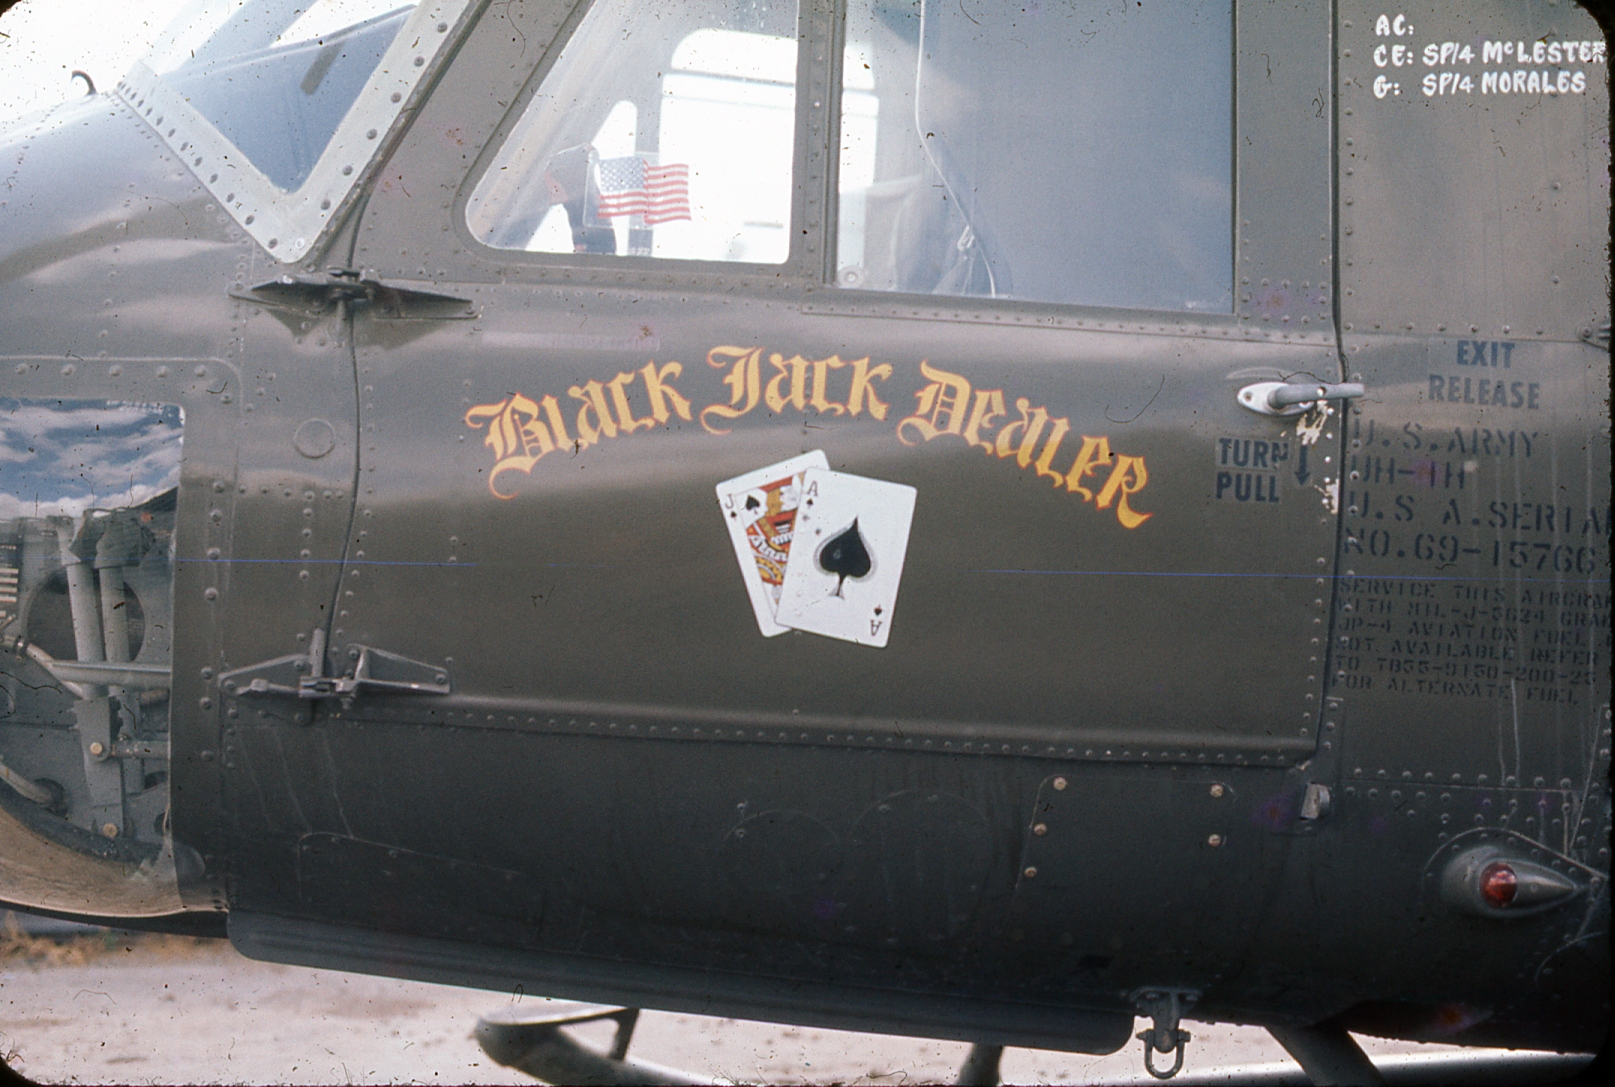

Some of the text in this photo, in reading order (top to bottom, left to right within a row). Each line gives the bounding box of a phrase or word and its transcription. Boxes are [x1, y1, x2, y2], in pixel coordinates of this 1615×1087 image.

[1375, 14, 1414, 36] AC:
[1373, 44, 1413, 67] CE:
[1422, 42, 1475, 67] SP/4
[1373, 70, 1586, 99] G: SP/4 MORALES
[1457, 340, 1515, 369] EXIT
[1428, 374, 1540, 410] RELEASE
[1218, 437, 1289, 468] TURN
[806, 480, 819, 497] A
[1216, 470, 1279, 502] PULL
[724, 493, 735, 510] J
[1408, 620, 1517, 643] AVIATION
[1391, 639, 1514, 662] AVAILABLE
